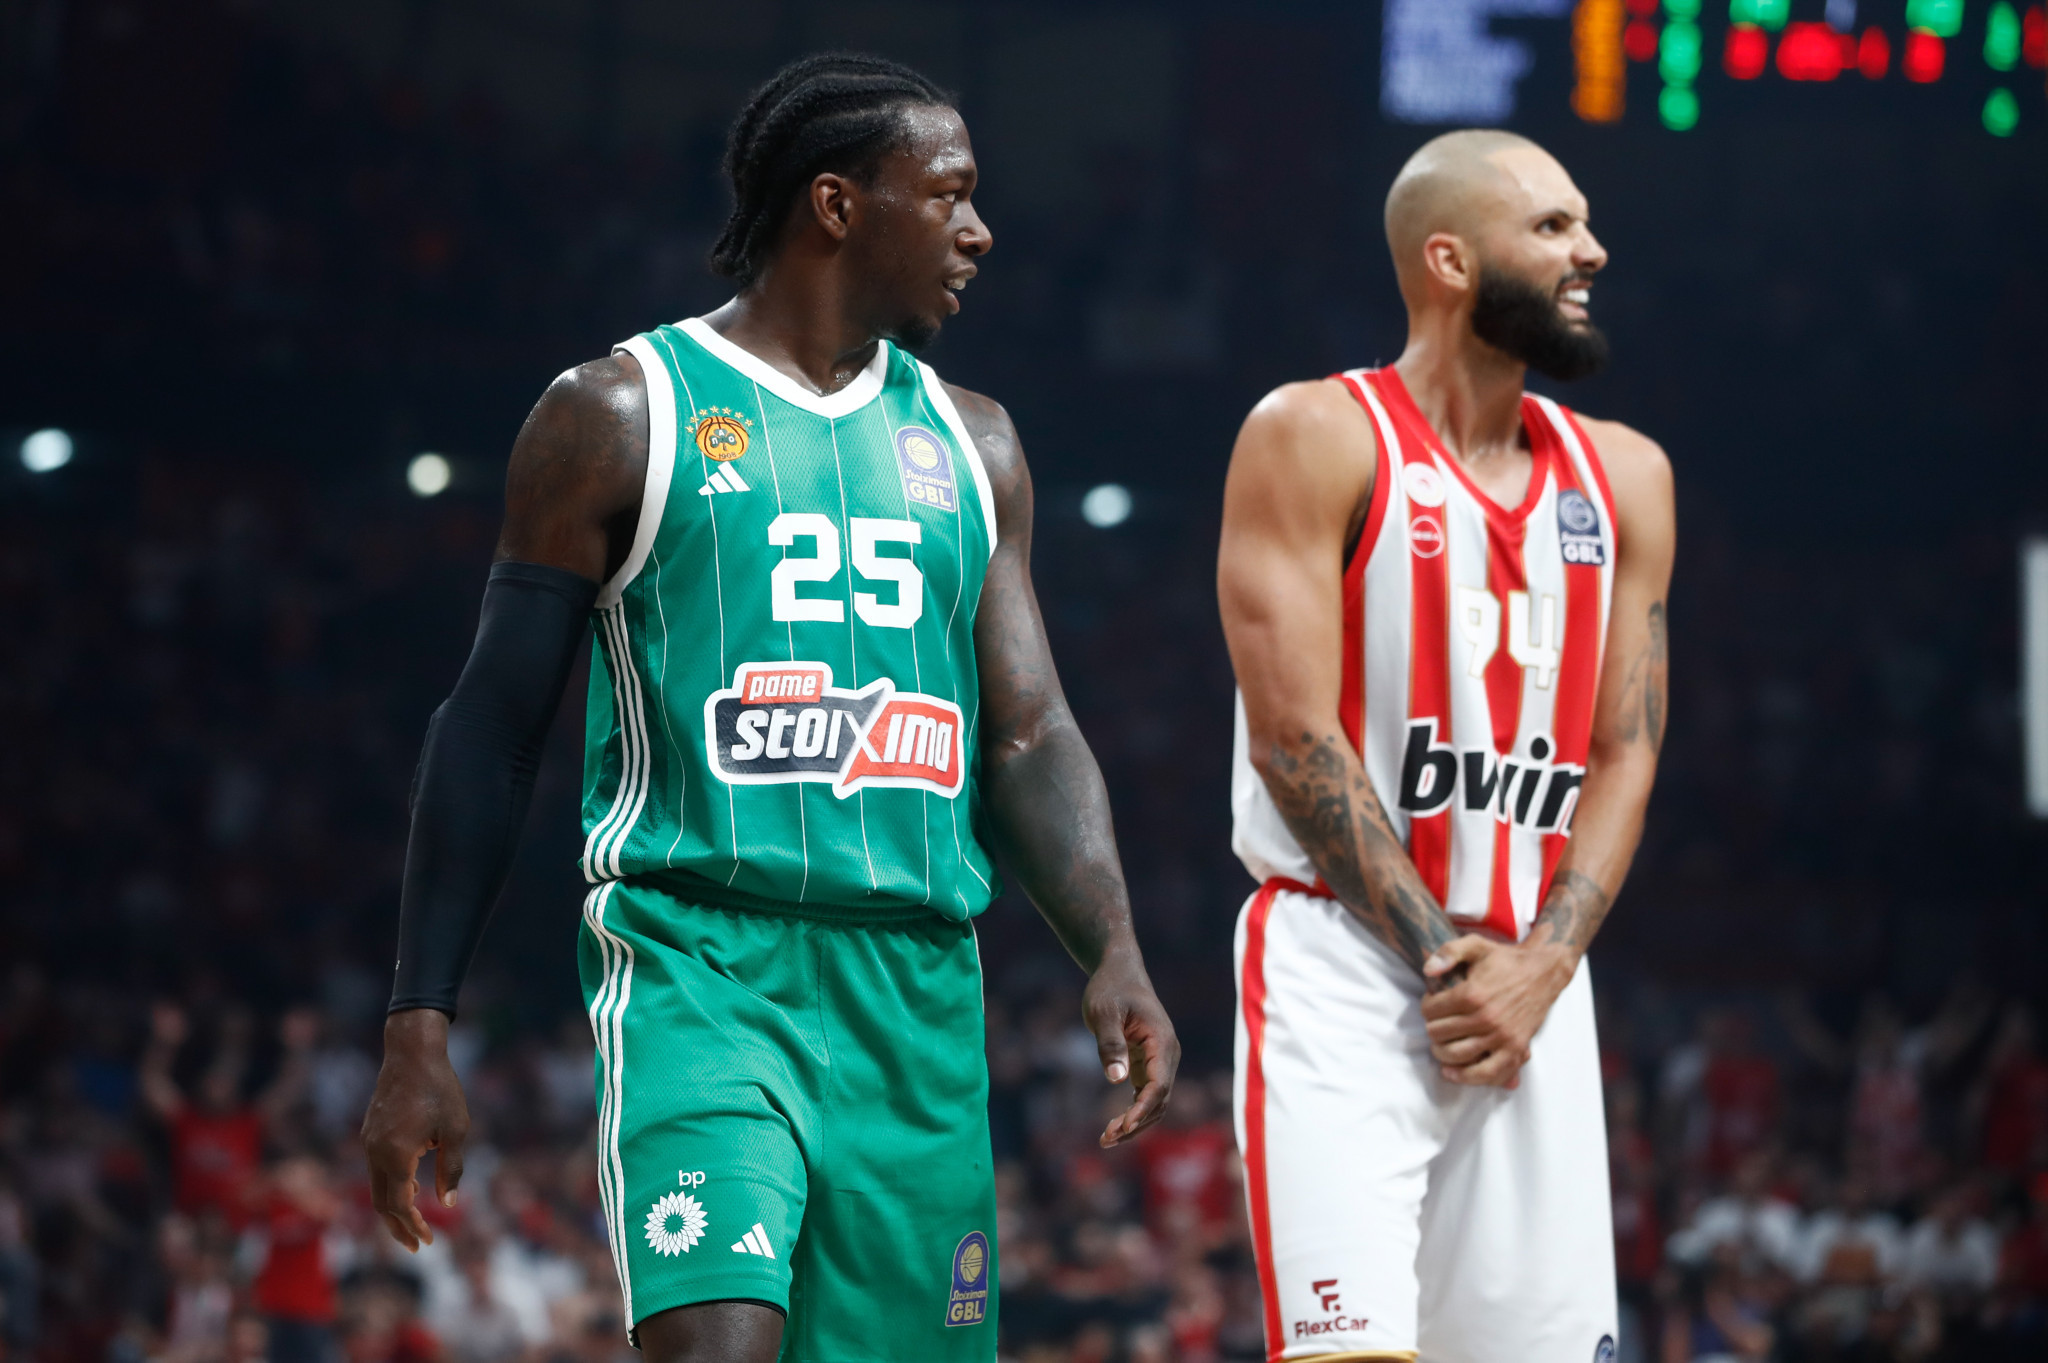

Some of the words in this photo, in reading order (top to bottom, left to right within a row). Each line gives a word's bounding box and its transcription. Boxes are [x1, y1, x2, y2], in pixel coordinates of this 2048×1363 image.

[905, 469, 951, 489] Stoiximan
[909, 481, 951, 508] GBL
[768, 513, 923, 629] 25
[1456, 585, 1560, 690] 94
[748, 674, 817, 701] pame
[678, 1169, 706, 1189] bp
[950, 1300, 983, 1322] GBL
[1294, 1315, 1369, 1340] FlexCar
